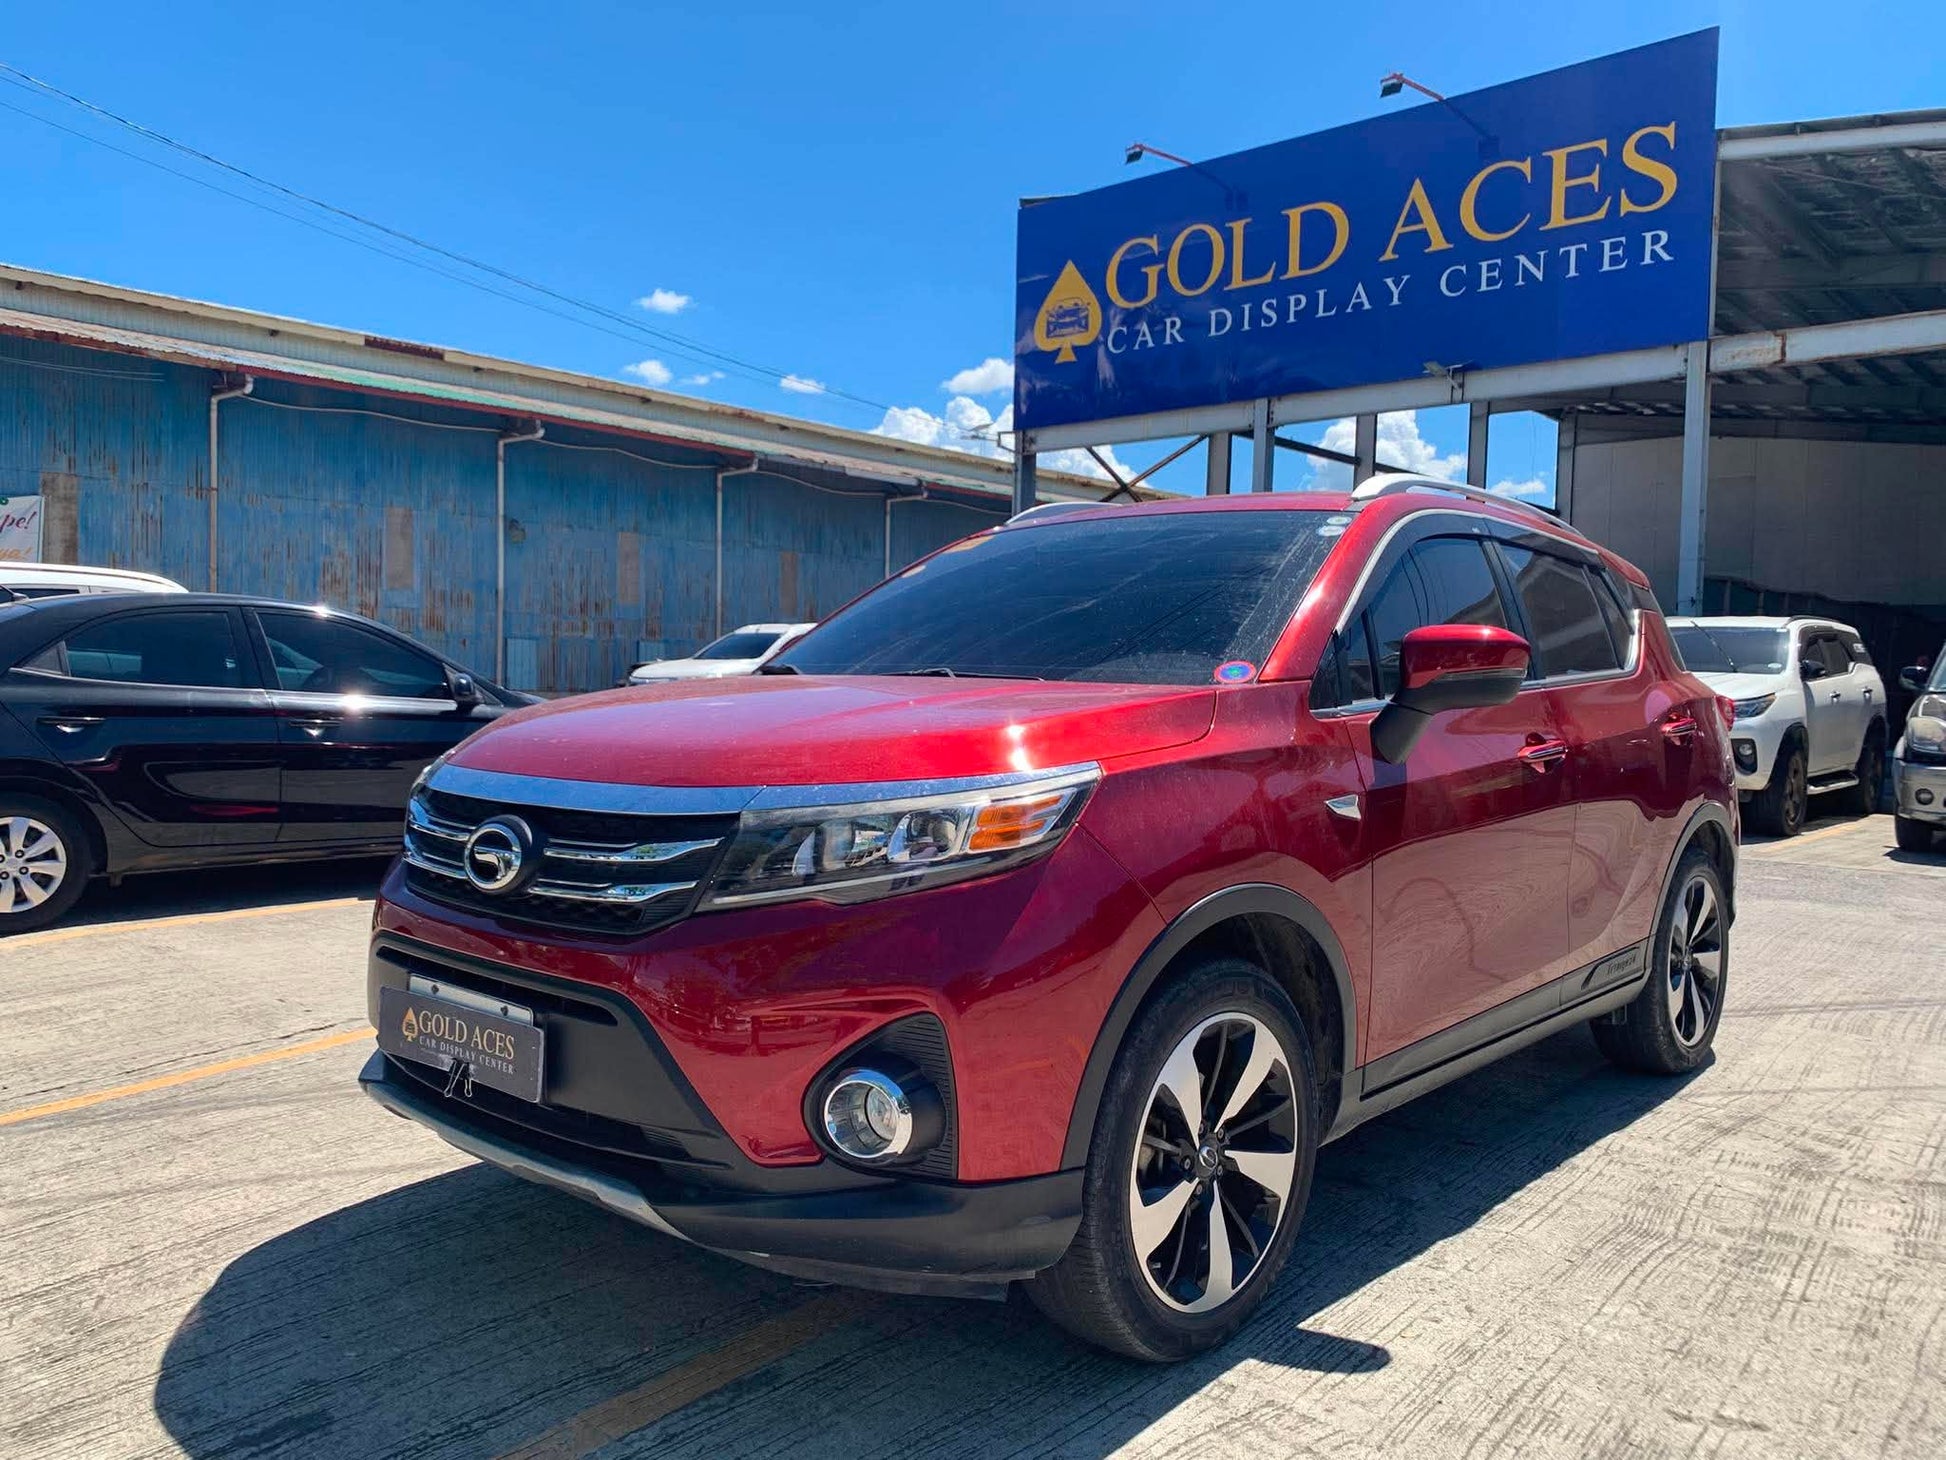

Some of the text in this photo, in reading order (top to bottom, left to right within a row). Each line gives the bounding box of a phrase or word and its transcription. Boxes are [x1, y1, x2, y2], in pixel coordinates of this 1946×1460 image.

[1107, 122, 1677, 308] GOLD ACES
[1107, 230, 1674, 353] CAR DISPLAY CENTER
[419, 1010, 515, 1060] GOLD ACES
[419, 1036, 513, 1075] CAR DISPLAY CENTER
